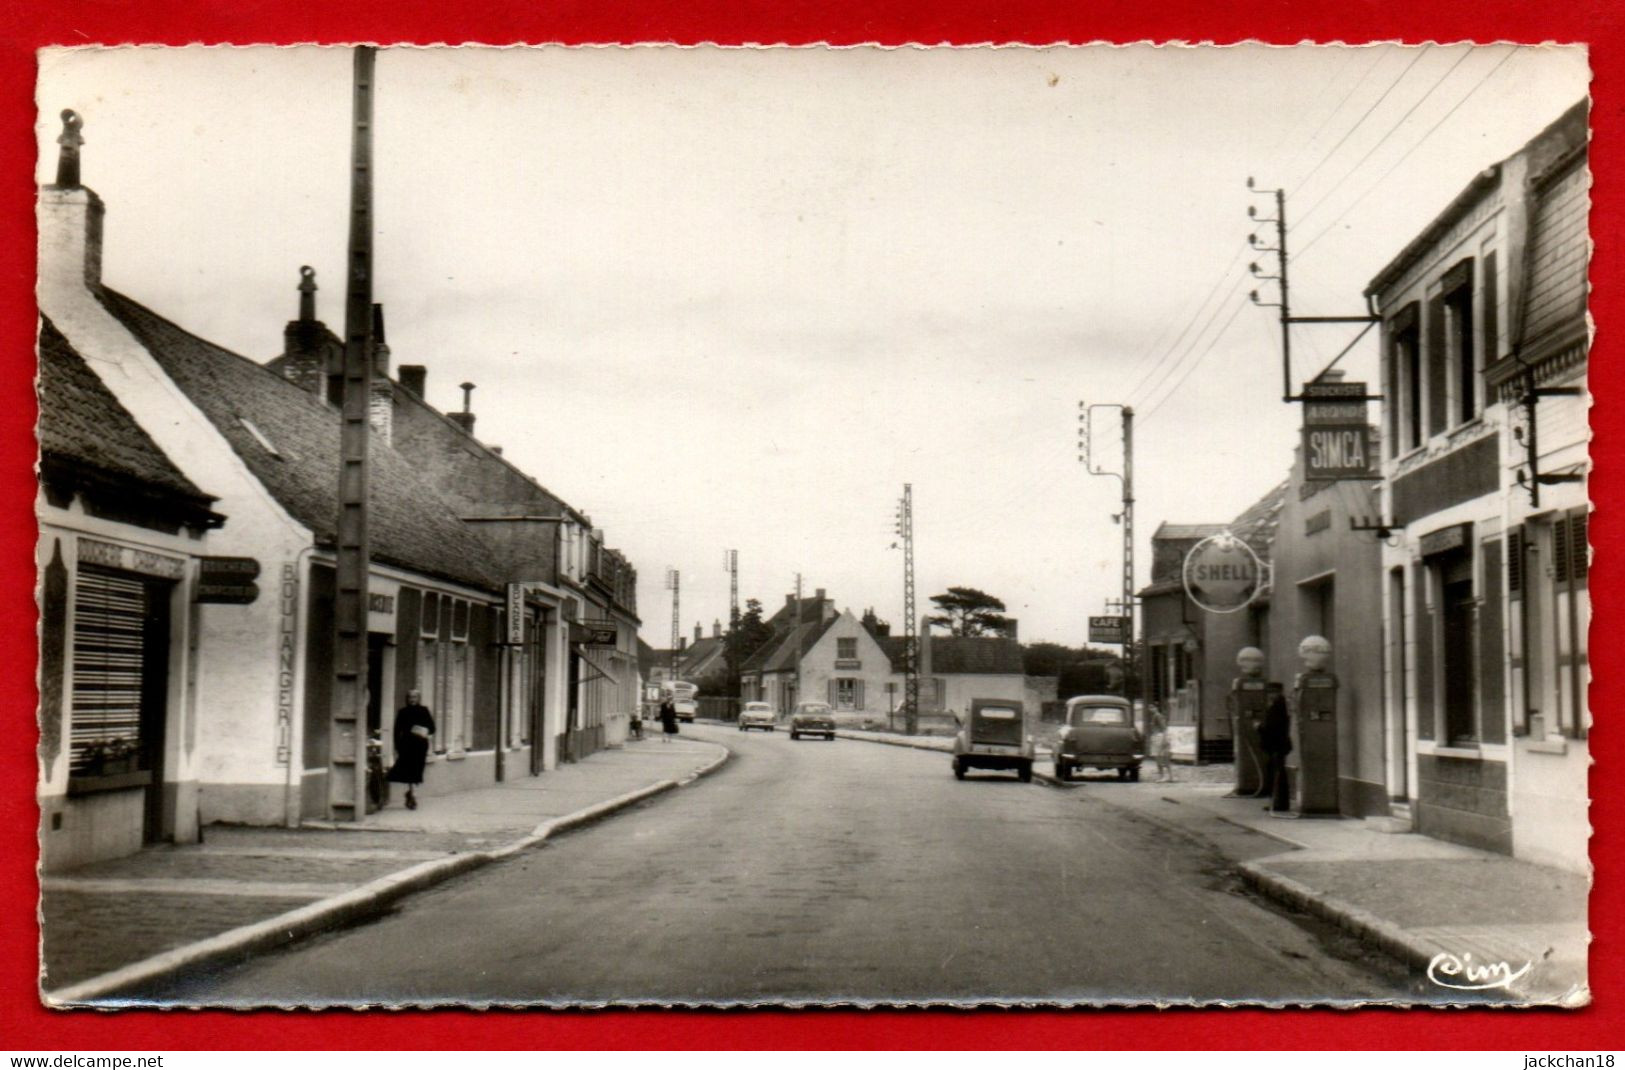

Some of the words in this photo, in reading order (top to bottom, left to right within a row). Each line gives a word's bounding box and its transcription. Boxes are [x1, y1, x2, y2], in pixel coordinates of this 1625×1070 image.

[1309, 405, 1367, 418] ARONDE
[1310, 431, 1365, 469] SIMCA
[1197, 564, 1250, 581] SHELL
[276, 564, 294, 764] BOULANGERIE
